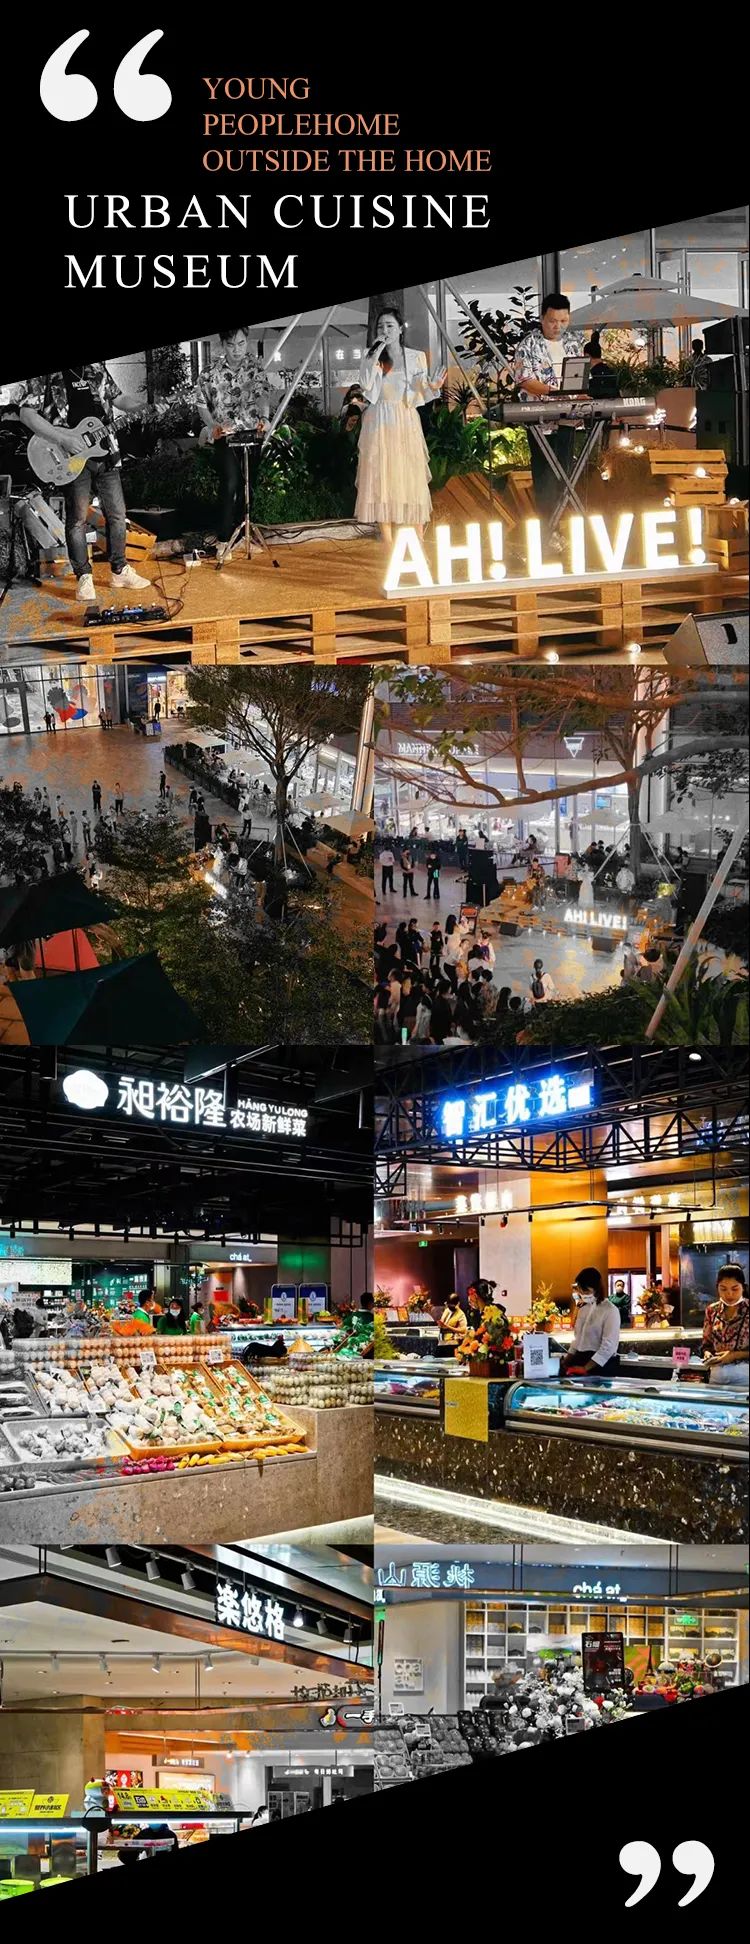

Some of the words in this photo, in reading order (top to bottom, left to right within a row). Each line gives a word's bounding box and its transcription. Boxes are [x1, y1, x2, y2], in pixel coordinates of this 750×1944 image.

[623, 398, 646, 406] KORG
[383, 522, 507, 589] AH!
[525, 507, 706, 578] LIVE!
[590, 911, 628, 930] LIVE!
[117, 1076, 227, 1128] 昶裕隆
[442, 1075, 567, 1138] 智汇优选
[230, 1109, 307, 1137] 农场新鲜菜
